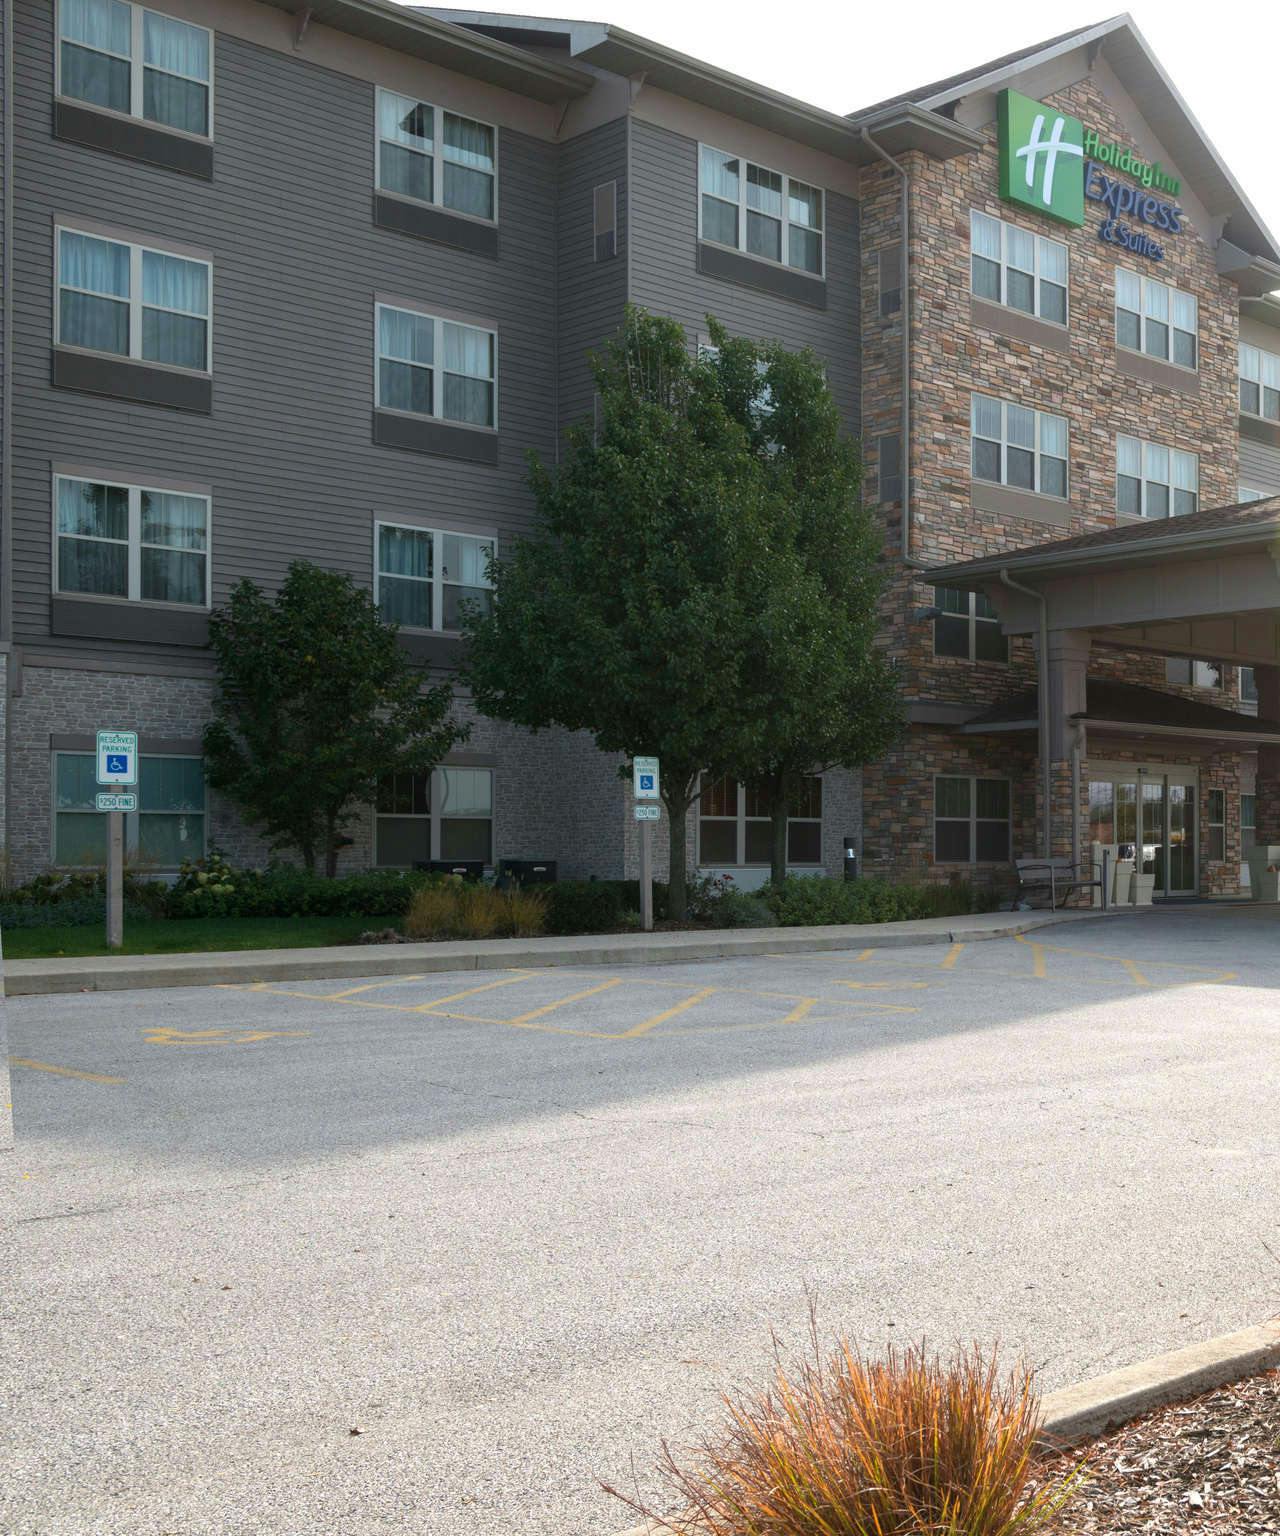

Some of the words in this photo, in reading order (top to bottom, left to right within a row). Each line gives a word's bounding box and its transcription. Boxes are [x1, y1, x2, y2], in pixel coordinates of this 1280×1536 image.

[1085, 129, 1152, 186] Holiday
[1153, 162, 1181, 196] Inn
[1085, 161, 1184, 232] Express
[1100, 219, 1118, 241] &
[1118, 225, 1165, 260] Suites
[100, 798, 116, 806] $250
[118, 798, 134, 806] FINE
